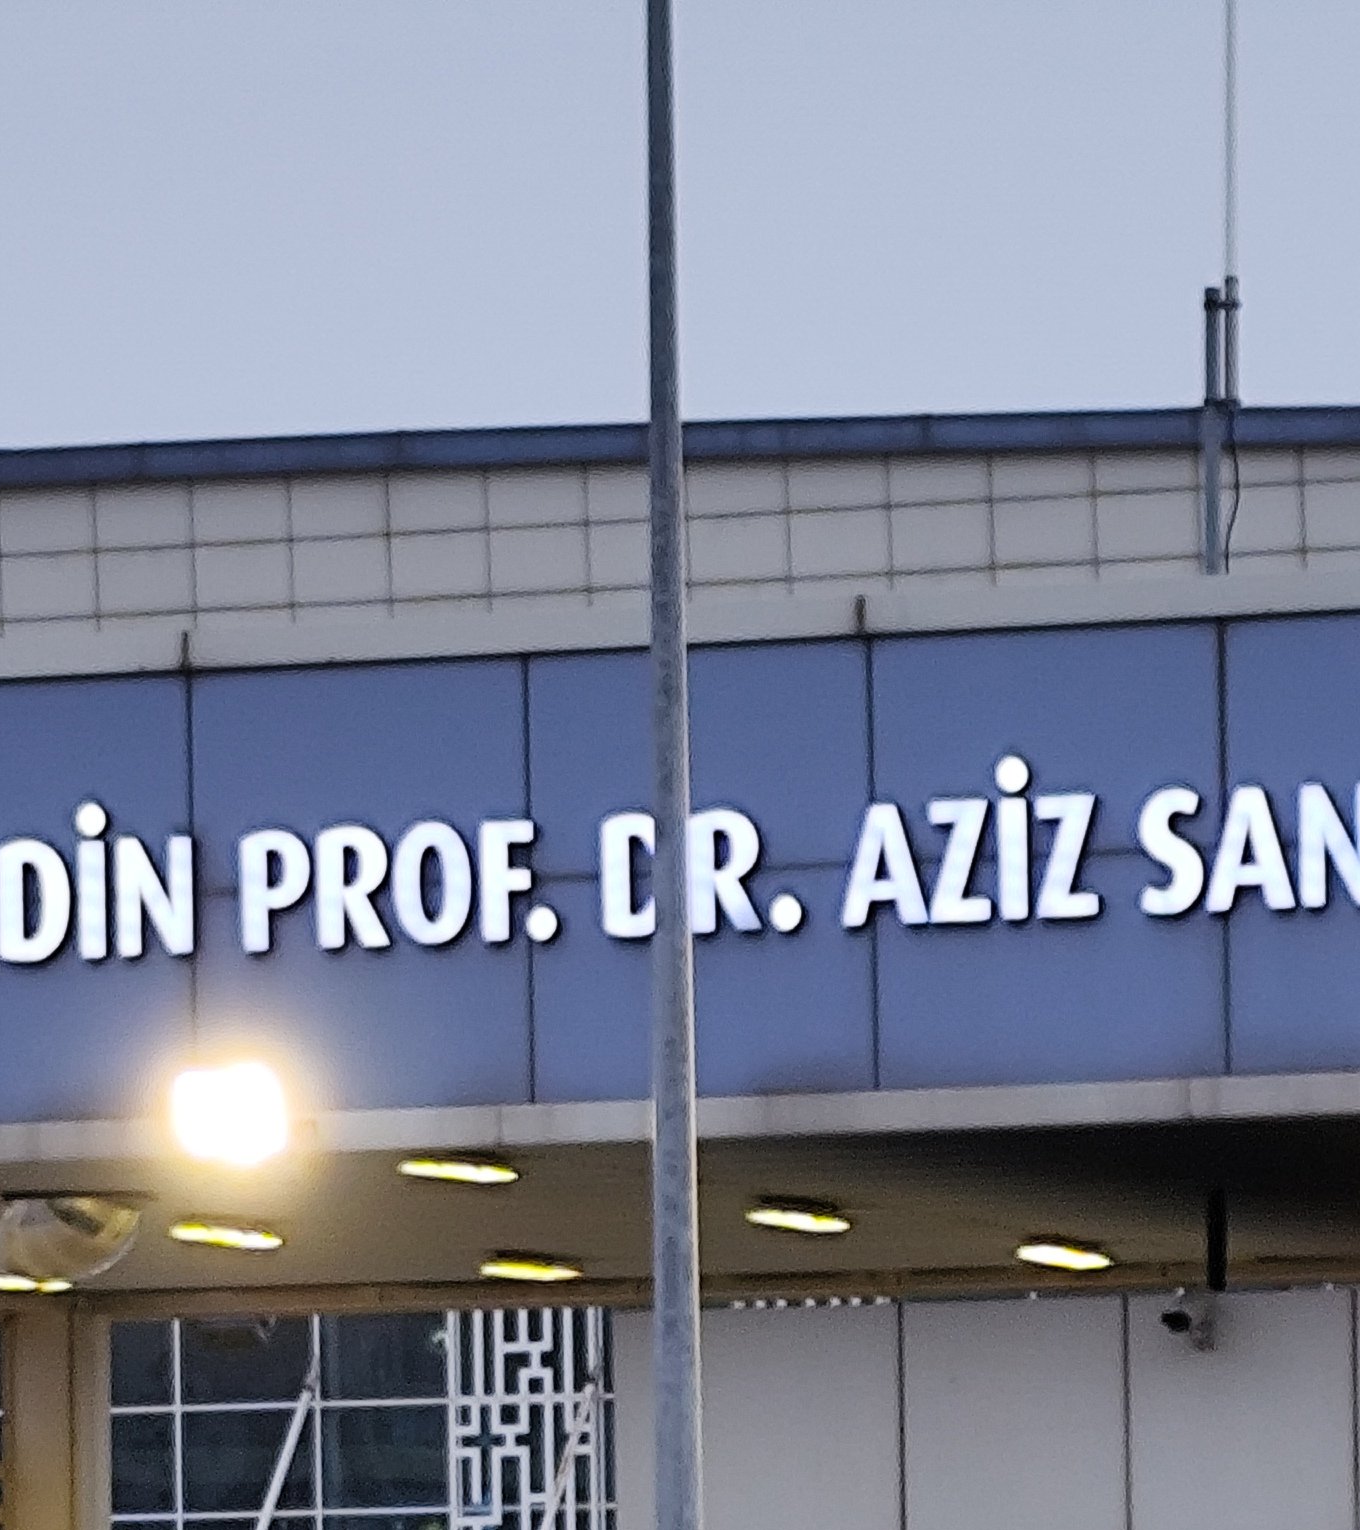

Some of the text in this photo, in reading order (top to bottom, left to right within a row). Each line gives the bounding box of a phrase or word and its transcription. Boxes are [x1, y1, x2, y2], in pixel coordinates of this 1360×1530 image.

[238, 819, 559, 954] PROF.
[599, 806, 803, 940] DR.
[841, 755, 1100, 928] AZİZ
